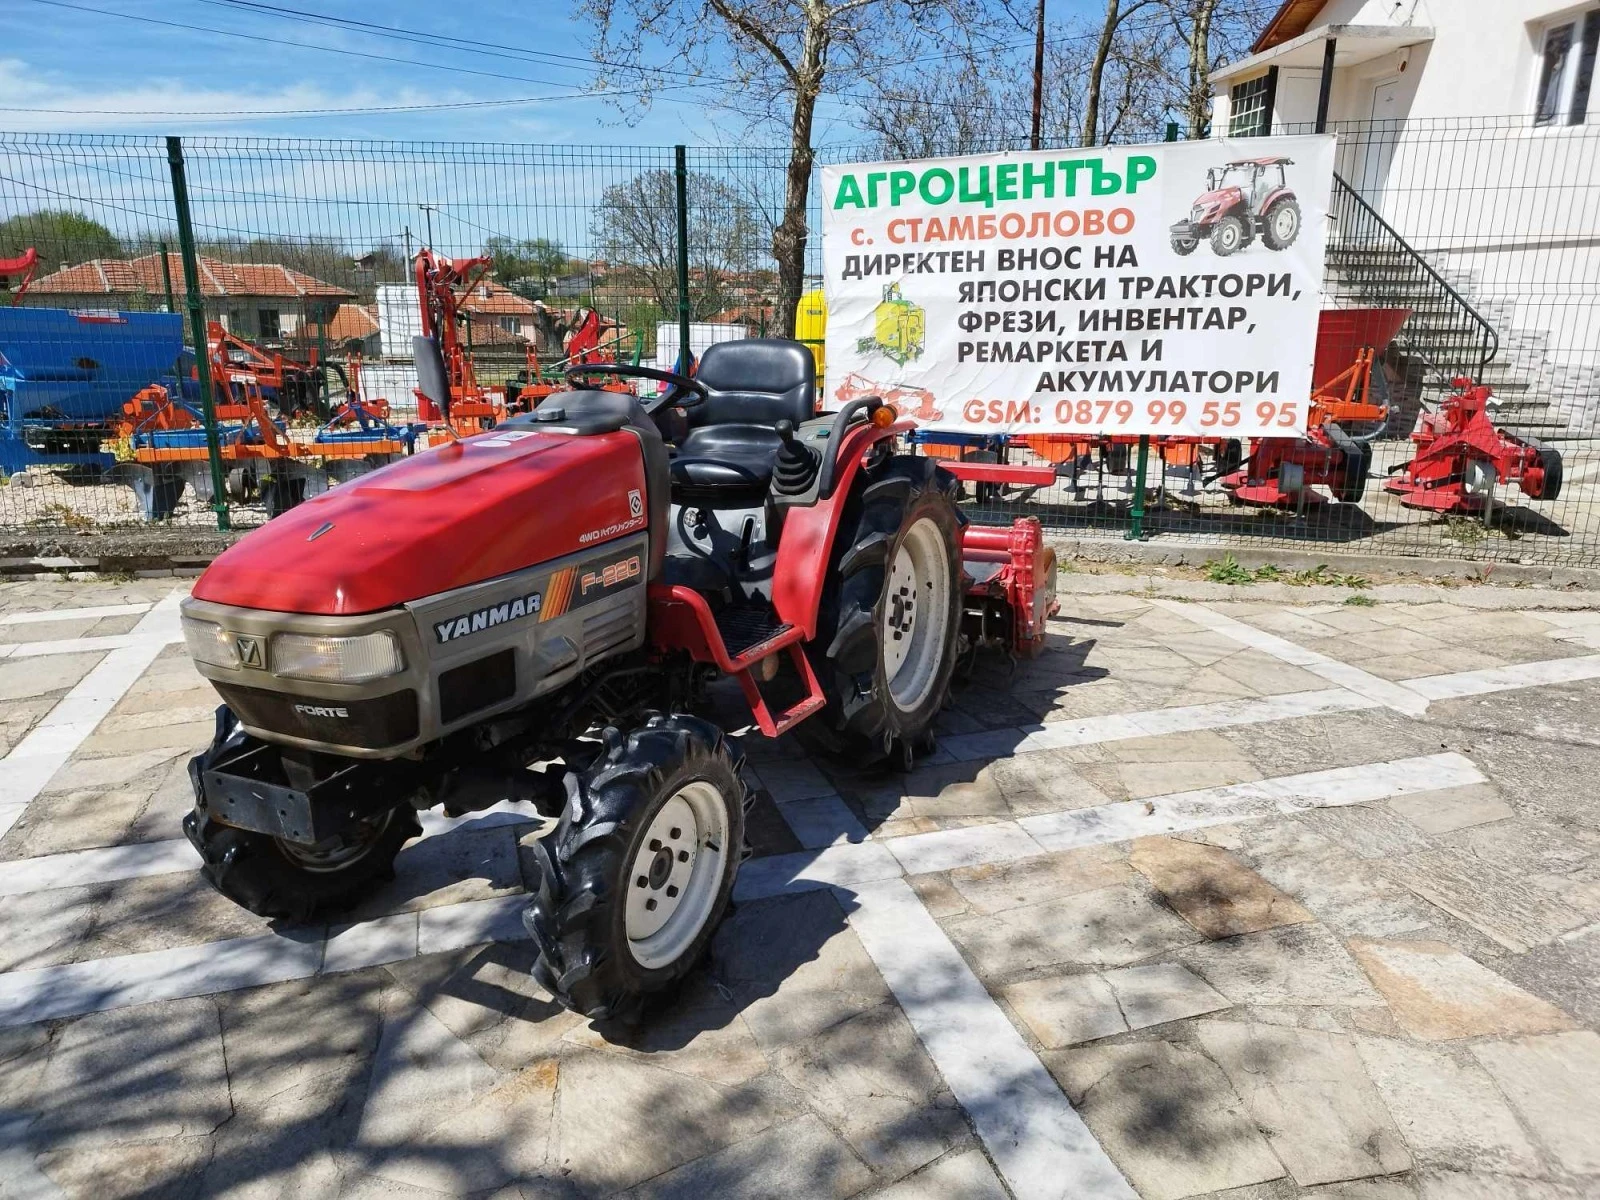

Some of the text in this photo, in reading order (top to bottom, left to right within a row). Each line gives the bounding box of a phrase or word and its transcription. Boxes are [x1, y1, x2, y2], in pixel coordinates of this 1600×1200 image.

[833, 155, 1157, 209] АГРОЦЕНТЪР
[851, 207, 1135, 246] с. СТАМБОЛОВО
[842, 244, 1138, 280] ДИРЕКТЕН ВНОС НА
[958, 273, 1302, 303] ЯПОНСКИ ТРАКТОРИ,
[957, 306, 1256, 336] ФРЕЗИ, ИНВЕНТАР,
[957, 339, 1163, 363] РЕМАРКЕТА И
[1035, 370, 1280, 393] АКУМУЛАТОРИ
[963, 399, 1297, 427] GSM: 0879 99 55 95
[581, 555, 641, 595] F-220
[435, 593, 541, 643] YANMAR
[294, 704, 349, 718] FORTE
